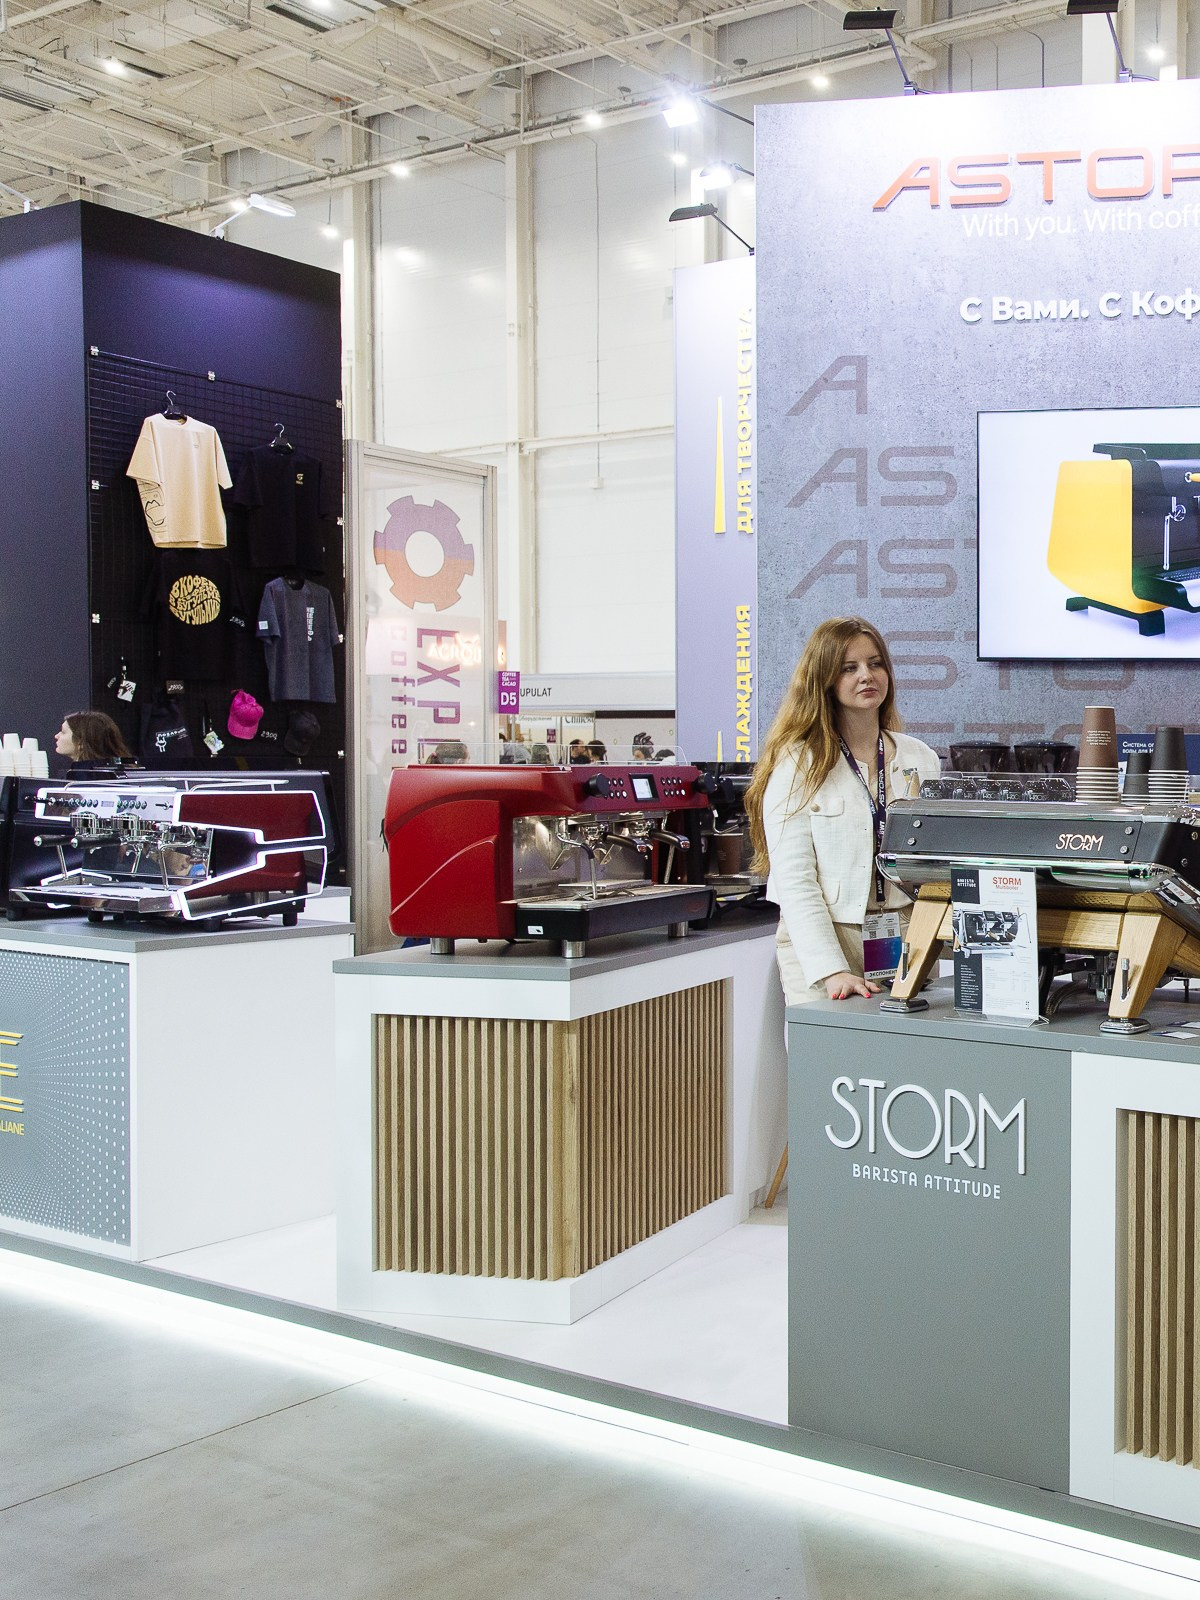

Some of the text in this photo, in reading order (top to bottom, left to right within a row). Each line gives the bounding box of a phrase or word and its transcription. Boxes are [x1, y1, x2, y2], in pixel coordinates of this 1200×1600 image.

[961, 213, 1018, 238] With
[1023, 213, 1076, 240] you.
[1083, 205, 1141, 233] With
[959, 297, 982, 322] С
[991, 294, 1089, 322] Вами.
[1099, 292, 1121, 317] С
[785, 355, 868, 416] A
[736, 306, 755, 535] ДЛЯ ТВОРЧЕСТВА
[784, 446, 958, 508] AS
[500, 692, 517, 706] D5
[1055, 833, 1104, 851] STORM
[992, 876, 1022, 886] STORM
[0, 1119, 25, 1136] LIANE
[824, 1076, 1027, 1175] STORM
[852, 1163, 1001, 1200] BARISTA ATTITUDE
